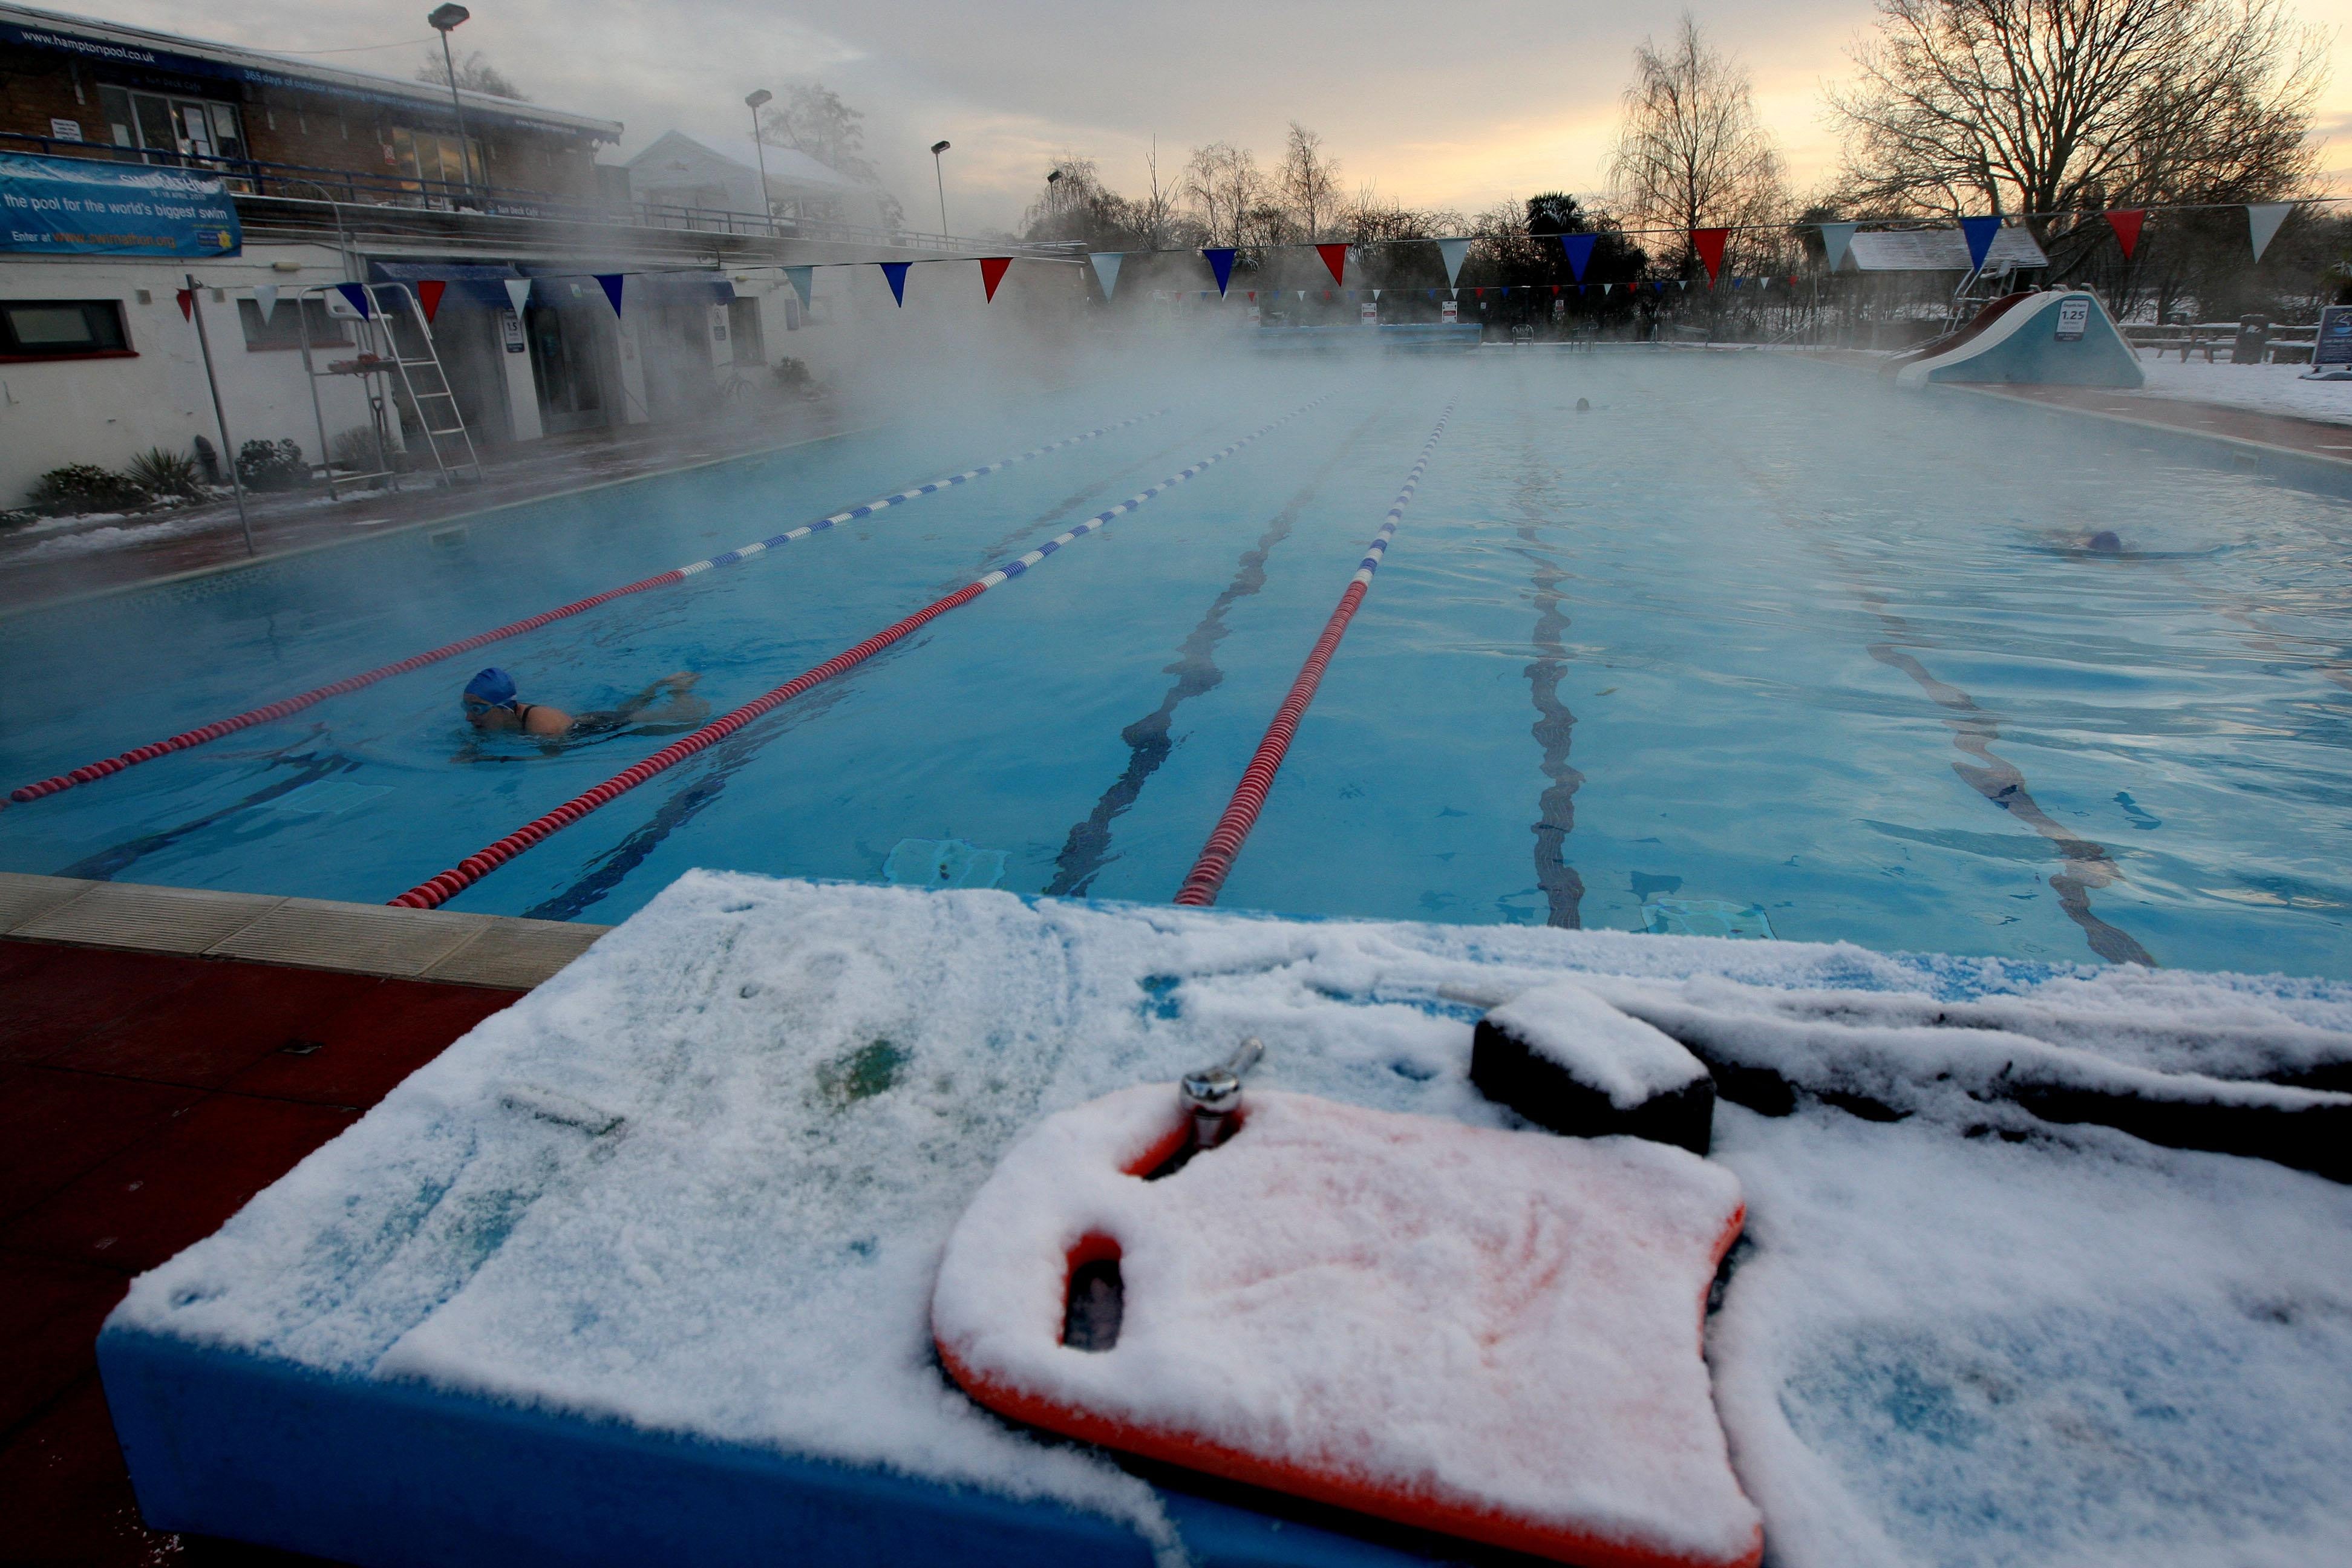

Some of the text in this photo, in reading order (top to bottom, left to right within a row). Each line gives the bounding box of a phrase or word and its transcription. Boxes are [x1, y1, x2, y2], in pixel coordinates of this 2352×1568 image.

[21, 30, 155, 63] www.hamptonpool.co.uk
[243, 70, 261, 81] 365
[262, 72, 282, 87] days
[4, 194, 228, 220] the pool for the world's biggest swim
[11, 230, 176, 250] Enter at www.swimathon.org
[2062, 310, 2085, 320] 1.25
